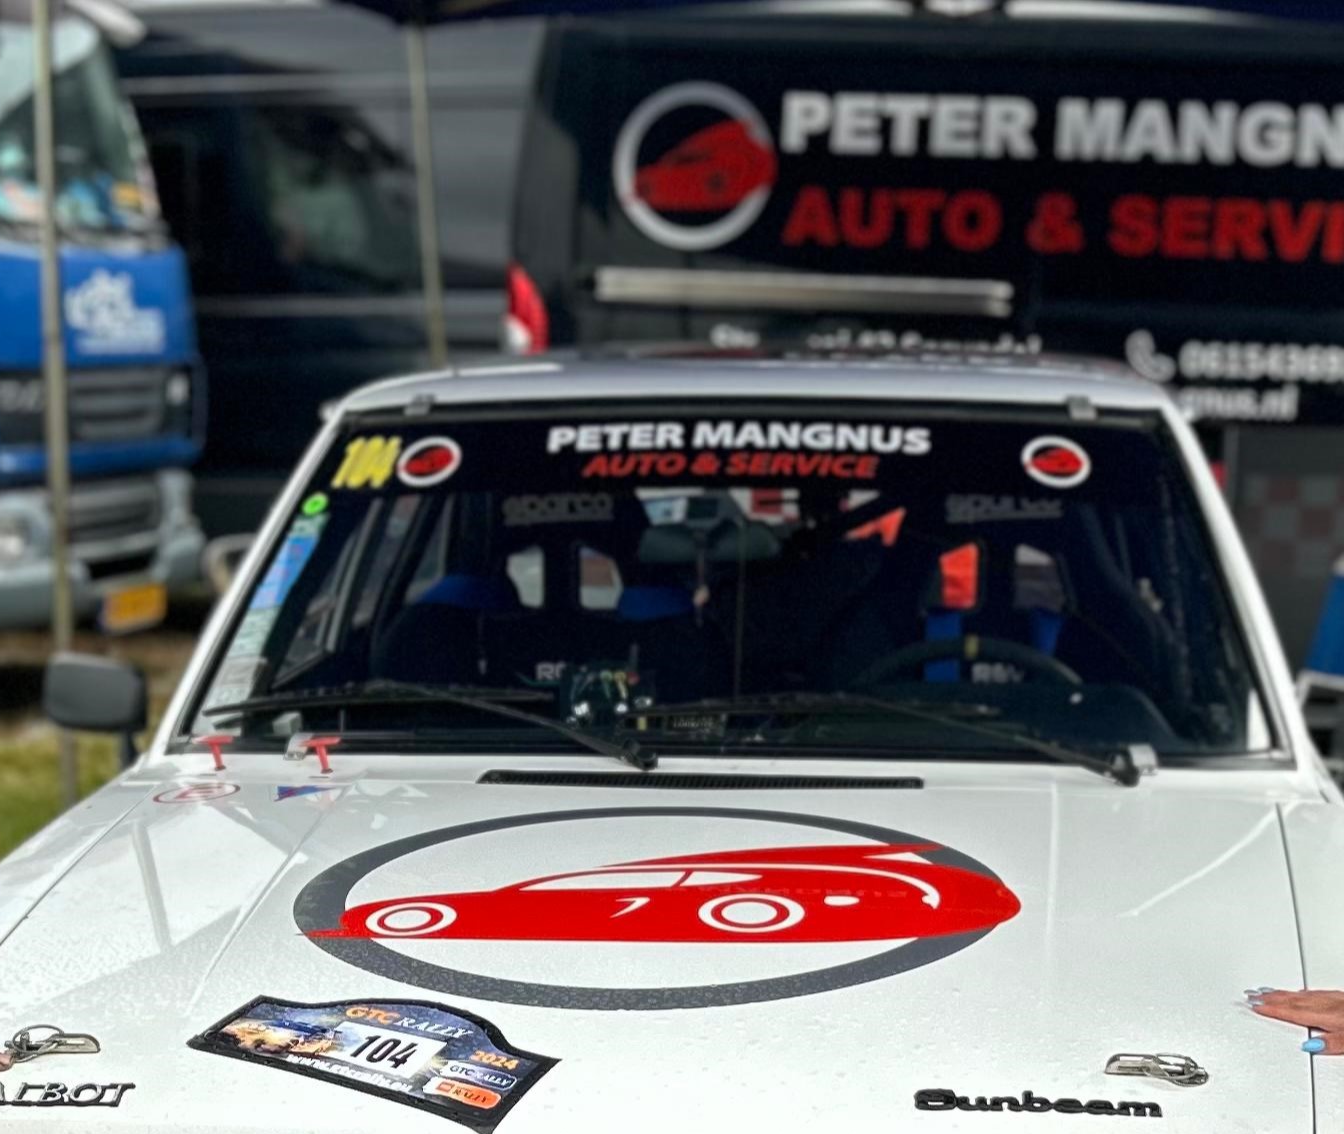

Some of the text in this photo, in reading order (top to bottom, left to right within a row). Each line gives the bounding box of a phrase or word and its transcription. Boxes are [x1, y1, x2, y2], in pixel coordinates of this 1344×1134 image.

[780, 91, 1038, 159] PETER
[782, 184, 1003, 250] AUTO
[1026, 191, 1084, 254] &
[547, 421, 931, 455] PETER MANGNUS
[331, 436, 403, 489] 104
[583, 454, 879, 478] AUTO & SERVICE
[346, 1007, 473, 1038] GTC RALLY
[350, 1035, 419, 1069] 104
[469, 1050, 519, 1070] 2024
[450, 1065, 475, 1077] GTC
[914, 1088, 1163, 1118] Sunbeam
